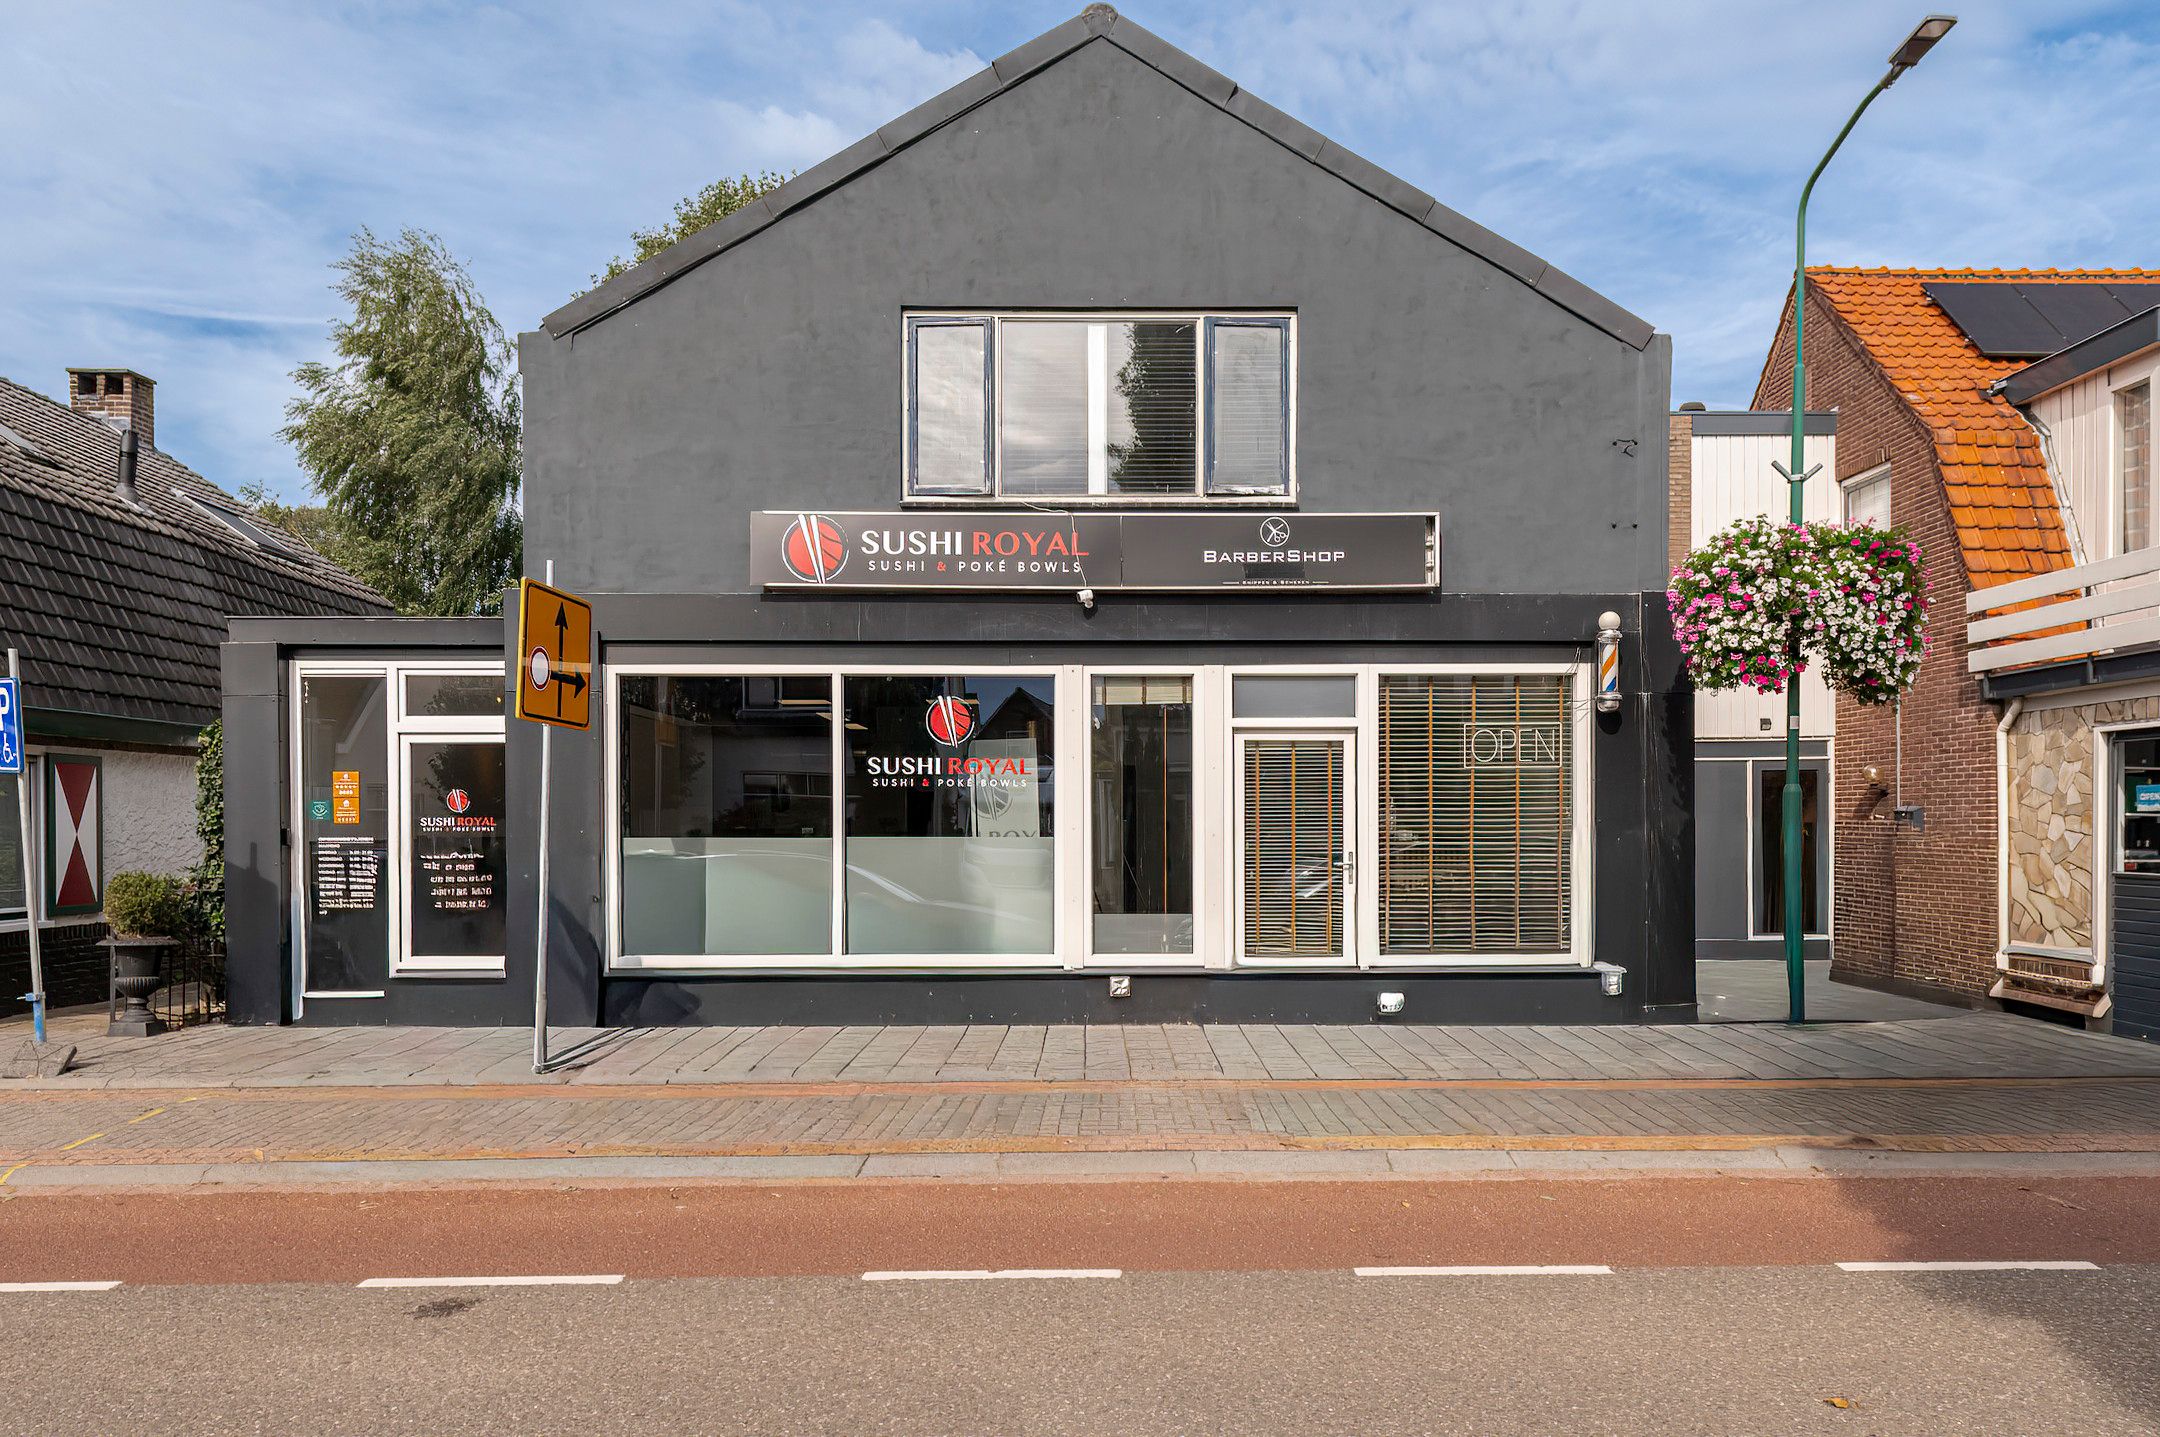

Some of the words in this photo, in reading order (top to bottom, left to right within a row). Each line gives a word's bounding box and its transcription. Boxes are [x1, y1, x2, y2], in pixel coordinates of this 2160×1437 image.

[861, 530, 963, 556] SUSHI
[972, 531, 1089, 557] ROYAL
[868, 560, 925, 572] SUSHI
[936, 560, 947, 572] &
[958, 557, 1006, 573] POKÉ
[1017, 561, 1081, 573] BOWLS
[1472, 729, 1555, 762] OPEN
[867, 757, 941, 775] SUSHI
[949, 758, 1032, 775] ROYAL
[872, 778, 914, 787] SUSHI
[921, 779, 930, 787] &
[980, 778, 1028, 788] BOWLS
[420, 817, 455, 826] SUSHI
[457, 817, 497, 826] ROYAL
